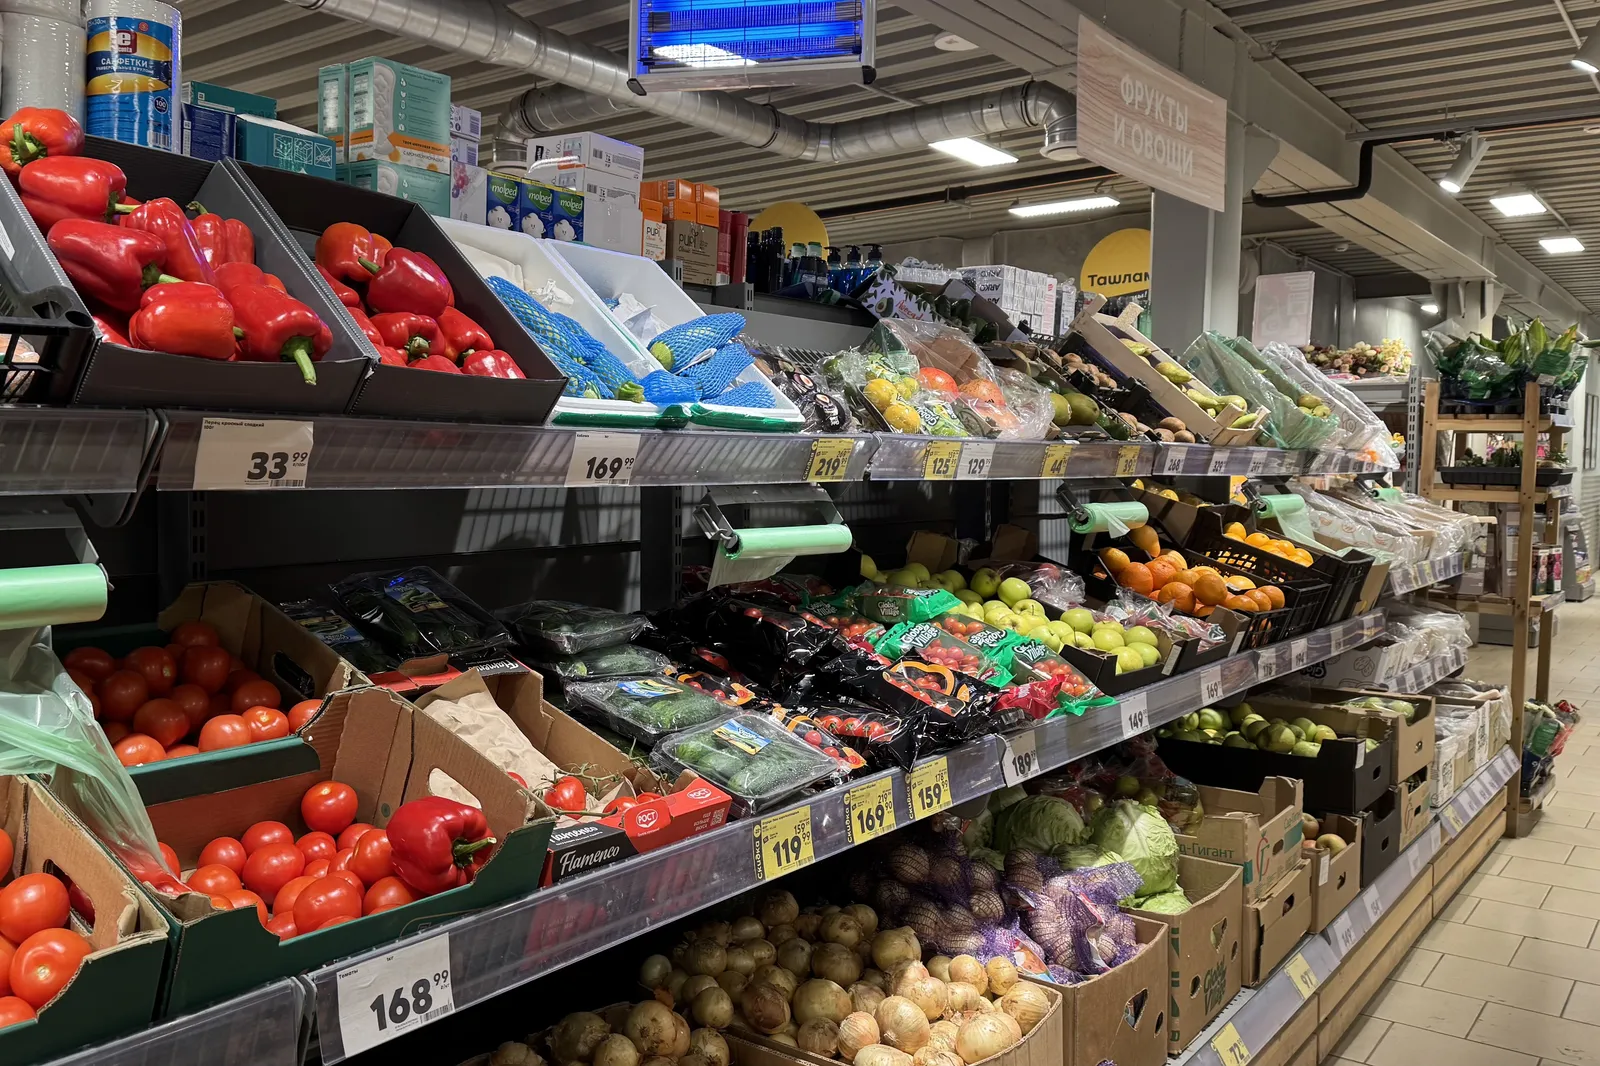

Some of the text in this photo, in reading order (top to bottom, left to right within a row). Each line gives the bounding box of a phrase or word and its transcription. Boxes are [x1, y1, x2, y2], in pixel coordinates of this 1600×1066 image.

[1120, 74, 1189, 134] ФРУКТЫ
[1114, 113, 1193, 177] И ОВОЩИ
[491, 183, 518, 197] molped
[528, 190, 553, 204] molped
[560, 197, 583, 211] molped
[247, 451, 308, 480] 33 99
[586, 456, 635, 479] 169 99
[815, 457, 841, 476] 219
[932, 458, 950, 475] 125
[968, 458, 985, 475] 129
[1050, 459, 1063, 474] 44
[877, 600, 898, 610] Global
[880, 605, 900, 616] Village
[901, 622, 930, 644] Global
[912, 626, 940, 648] Village
[1023, 643, 1047, 662] Village
[468, 659, 519, 672] Flameno
[1206, 682, 1219, 699] 169
[1128, 710, 1143, 730] 149
[1012, 752, 1031, 776] 189
[918, 783, 942, 810] 159
[638, 812, 656, 824] РОСТ
[857, 801, 893, 834] 169 90
[793, 822, 806, 835] 159
[773, 831, 810, 867] 119 99
[1174, 842, 1235, 859] д-Гигант
[560, 845, 620, 876] Flamenco
[338, 969, 359, 980] Томаты
[1300, 971, 1314, 989] 97
[369, 969, 449, 1031] 168 99
[1228, 1042, 1245, 1065] 72
